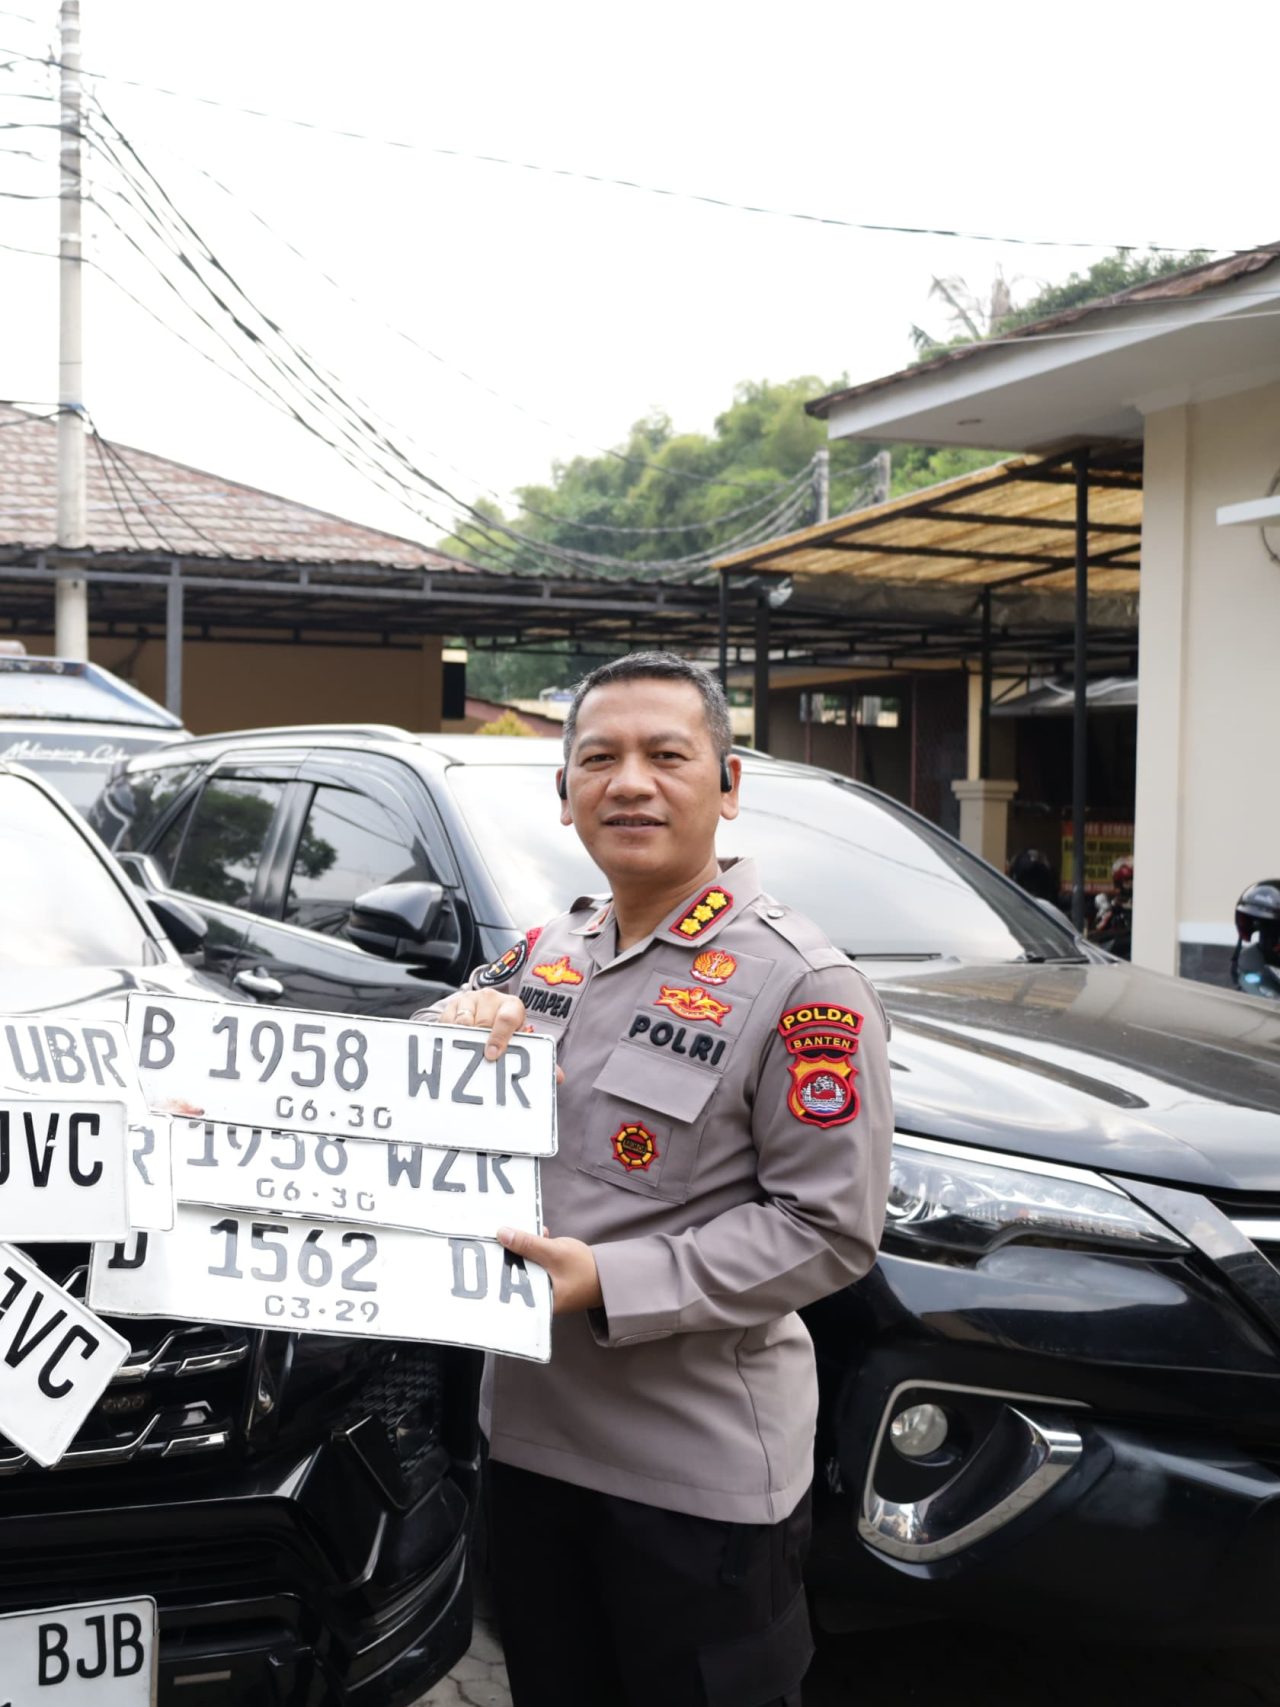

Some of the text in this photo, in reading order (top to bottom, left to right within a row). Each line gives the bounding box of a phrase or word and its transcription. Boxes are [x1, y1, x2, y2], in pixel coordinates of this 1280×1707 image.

[628, 1015, 726, 1067] POLRI
[782, 1007, 855, 1030] POLDA
[793, 1036, 851, 1049] BANTEN
[4, 1024, 128, 1088] UBR
[139, 1006, 532, 1109] B 1958 WZR
[207, 1219, 378, 1292] 1562
[447, 1237, 536, 1308] DA
[264, 1295, 380, 1323] 03.29
[37, 1612, 146, 1687] BJB
